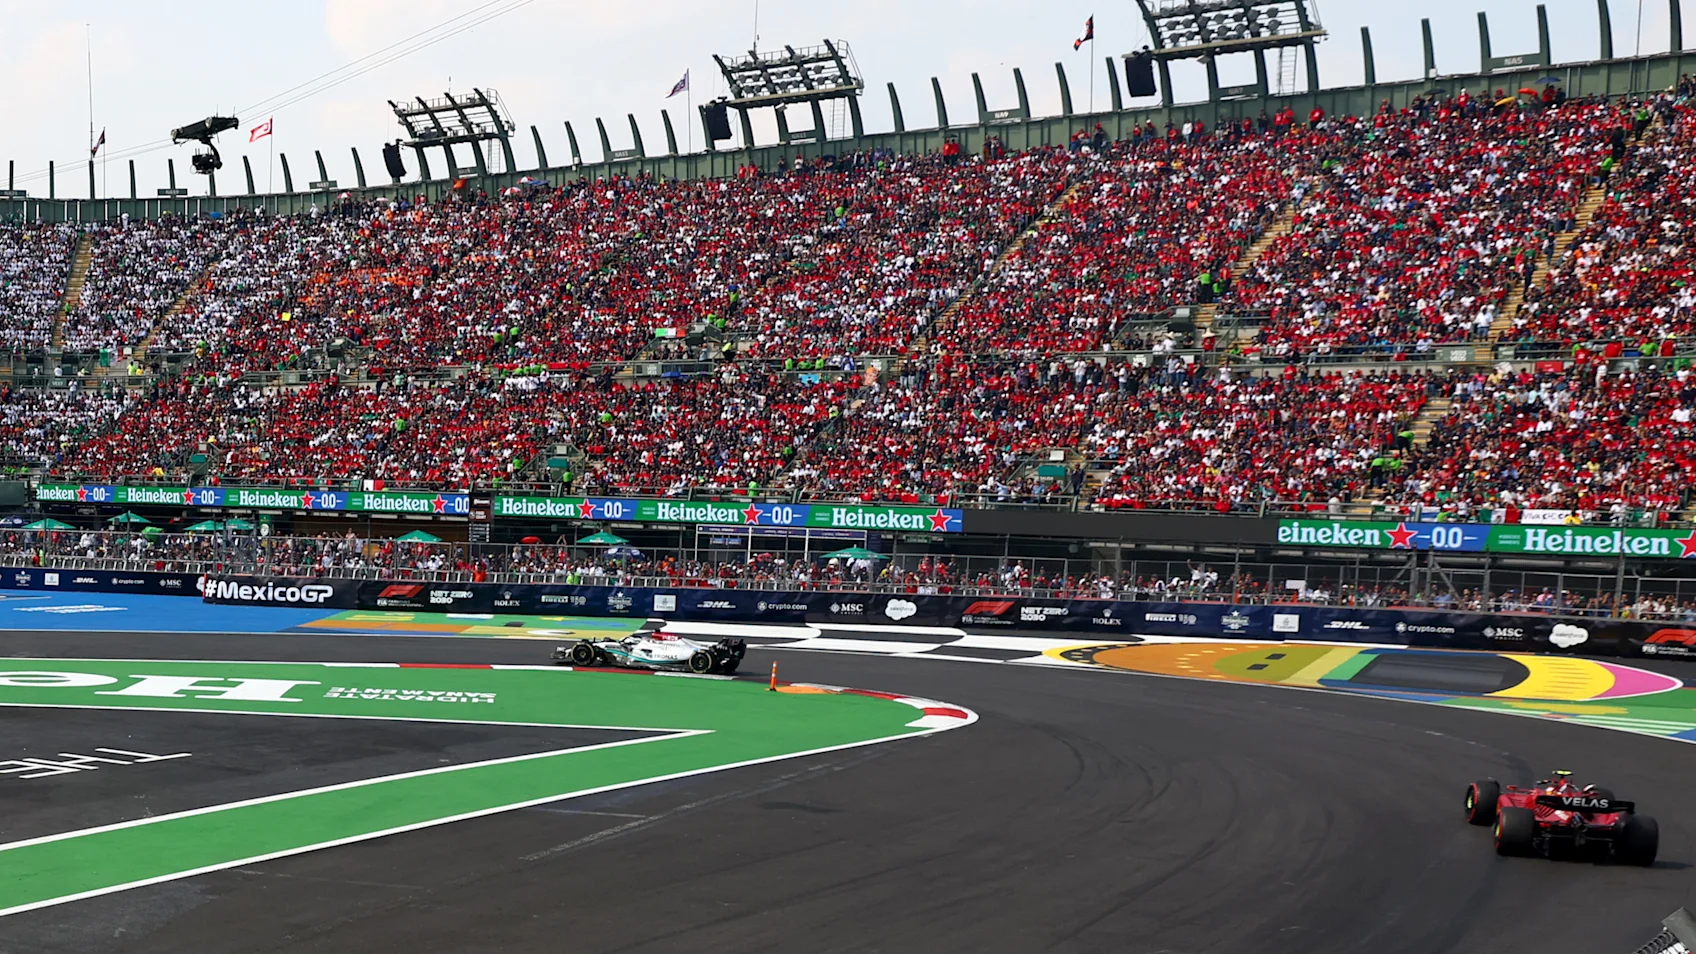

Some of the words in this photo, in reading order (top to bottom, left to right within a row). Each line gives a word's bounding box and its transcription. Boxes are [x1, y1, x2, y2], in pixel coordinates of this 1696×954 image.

[92, 487, 106, 501] 0.0
[127, 488, 180, 504] Heineken
[200, 490, 215, 505] 0.0
[239, 491, 299, 508] Heineken
[321, 493, 337, 508] 0.0
[363, 494, 430, 511] Heineken
[501, 497, 575, 517] Heineken
[603, 501, 622, 519] 0.0
[656, 502, 740, 523] Heineken
[771, 506, 792, 525] 0.0
[831, 508, 925, 530] Heineken
[1431, 526, 1463, 548] 0.0
[1523, 527, 1670, 554] Heineken
[166, 579, 182, 587] MSC
[204, 581, 334, 604] #MexicoGP
[494, 599, 520, 607] ROLEX
[767, 603, 808, 611] crypto.com
[840, 603, 863, 612] MSC
[1020, 606, 1040, 615] NET
[1043, 607, 1068, 616] ZERO
[1020, 613, 1046, 621] 2030
[1092, 617, 1121, 626] ROLEX
[1407, 624, 1455, 634] crypto.com
[1496, 627, 1524, 638] MSC
[323, 691, 495, 704] HIDRATATE
[329, 687, 496, 698] SANAMENTE
[1561, 796, 1609, 809] VELAS
